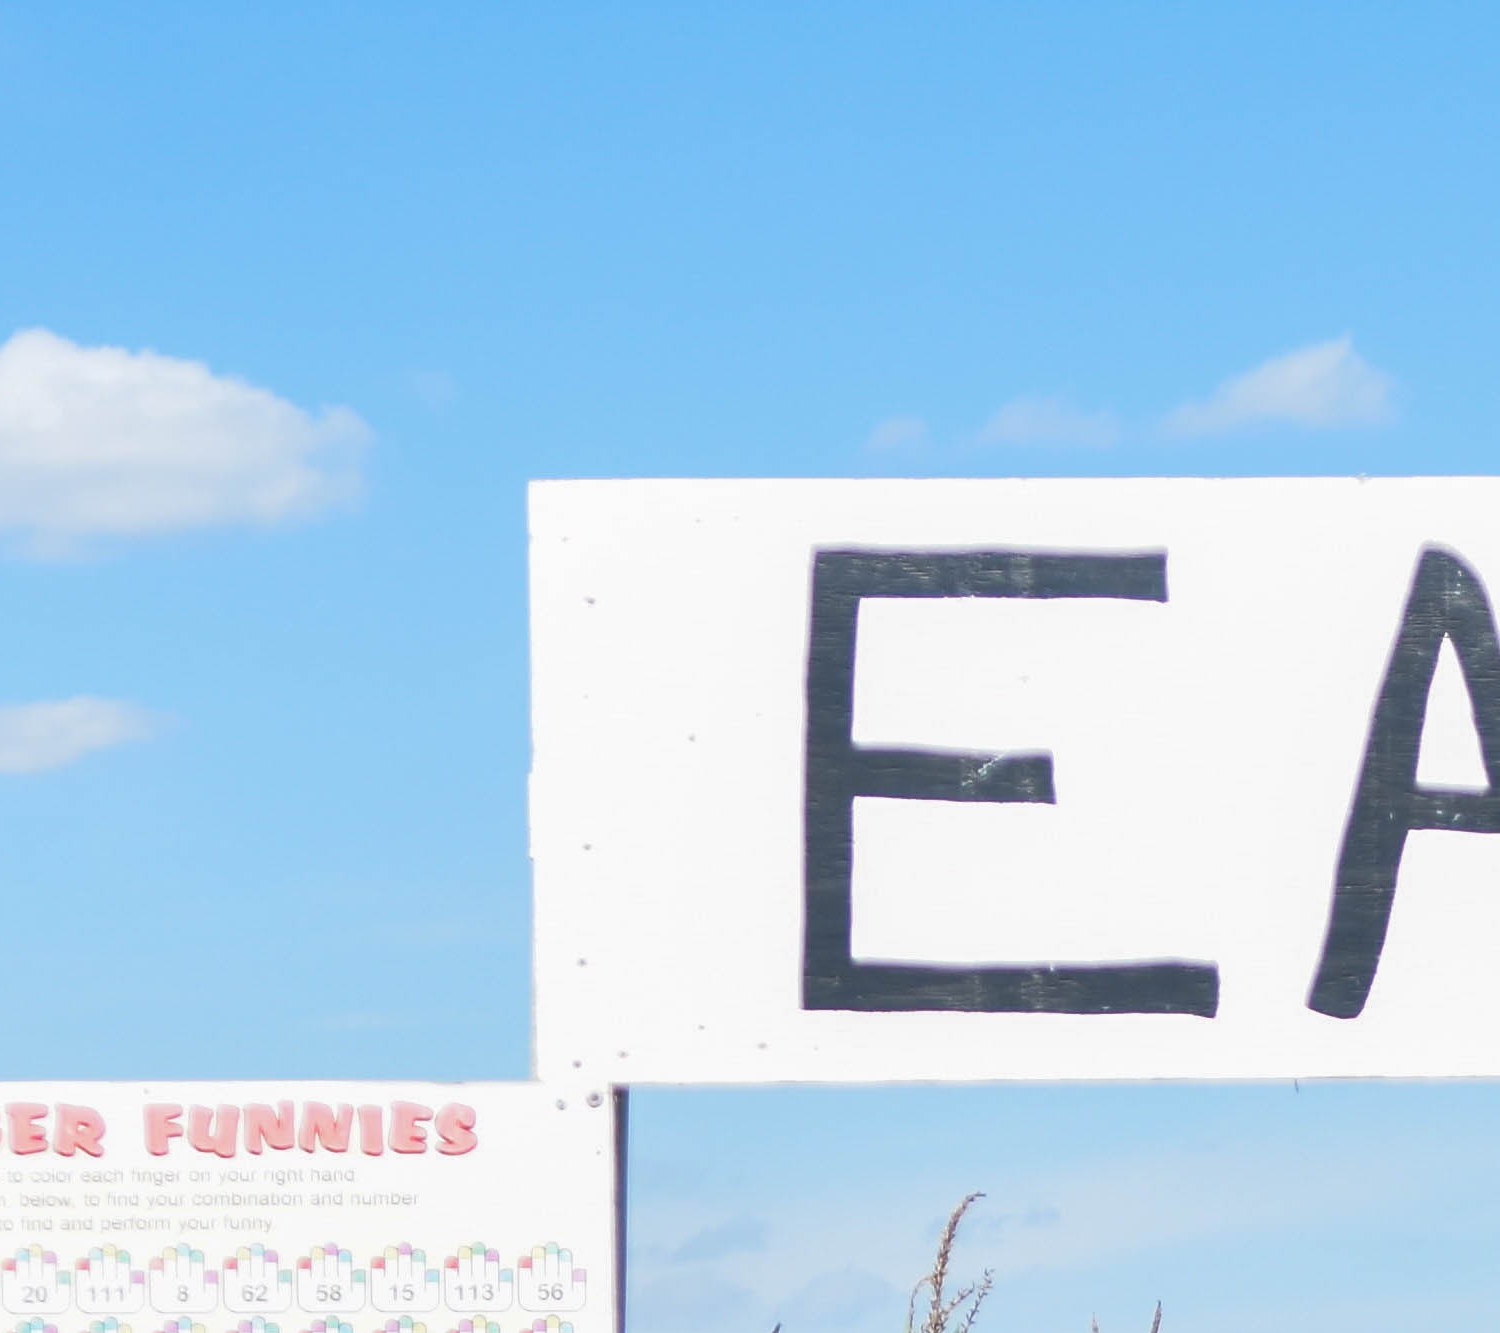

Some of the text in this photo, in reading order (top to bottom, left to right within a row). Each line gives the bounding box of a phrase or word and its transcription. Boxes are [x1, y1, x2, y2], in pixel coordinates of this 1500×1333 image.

[144, 1100, 478, 1158] FUNNIES
[22, 1286, 47, 1304] 20
[88, 1286, 124, 1302] 111
[177, 1286, 189, 1304] 8
[242, 1285, 268, 1302] 62
[317, 1285, 342, 1302] 58
[389, 1284, 414, 1301] 15
[455, 1284, 494, 1301] 113
[538, 1283, 563, 1301] 56
